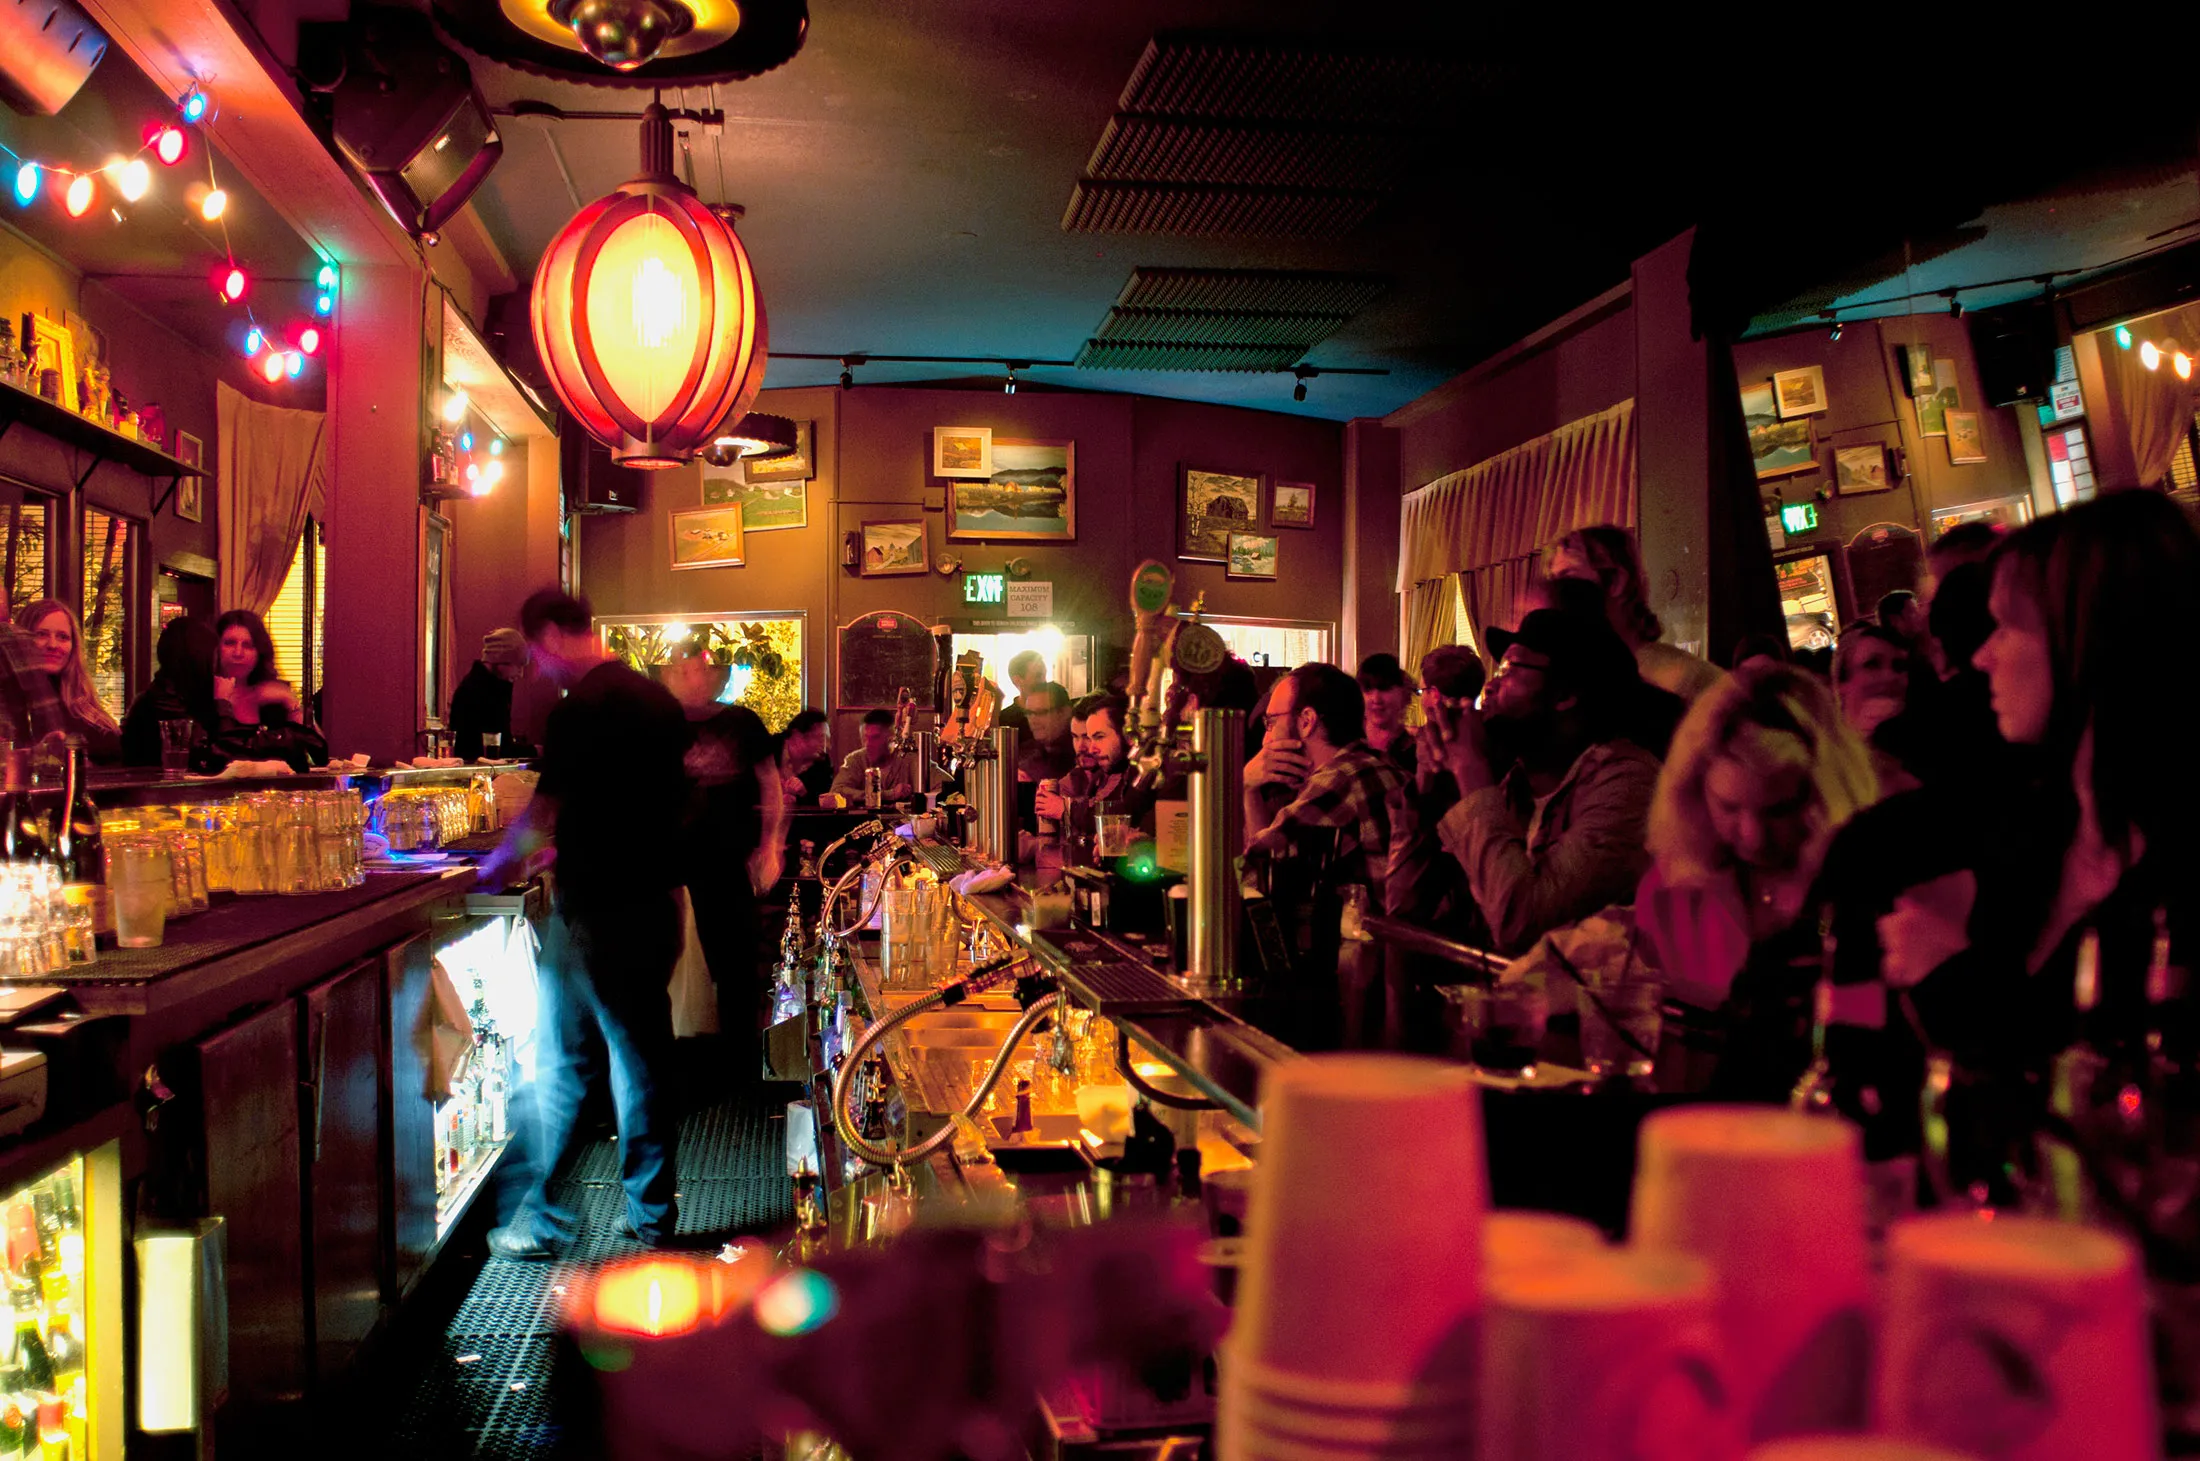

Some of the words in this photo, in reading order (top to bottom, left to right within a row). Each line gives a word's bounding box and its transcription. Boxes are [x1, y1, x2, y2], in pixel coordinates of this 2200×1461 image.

[965, 575, 1003, 602] EXIT
[1010, 594, 1048, 602] CAPACITY
[1021, 603, 1038, 612] 108
